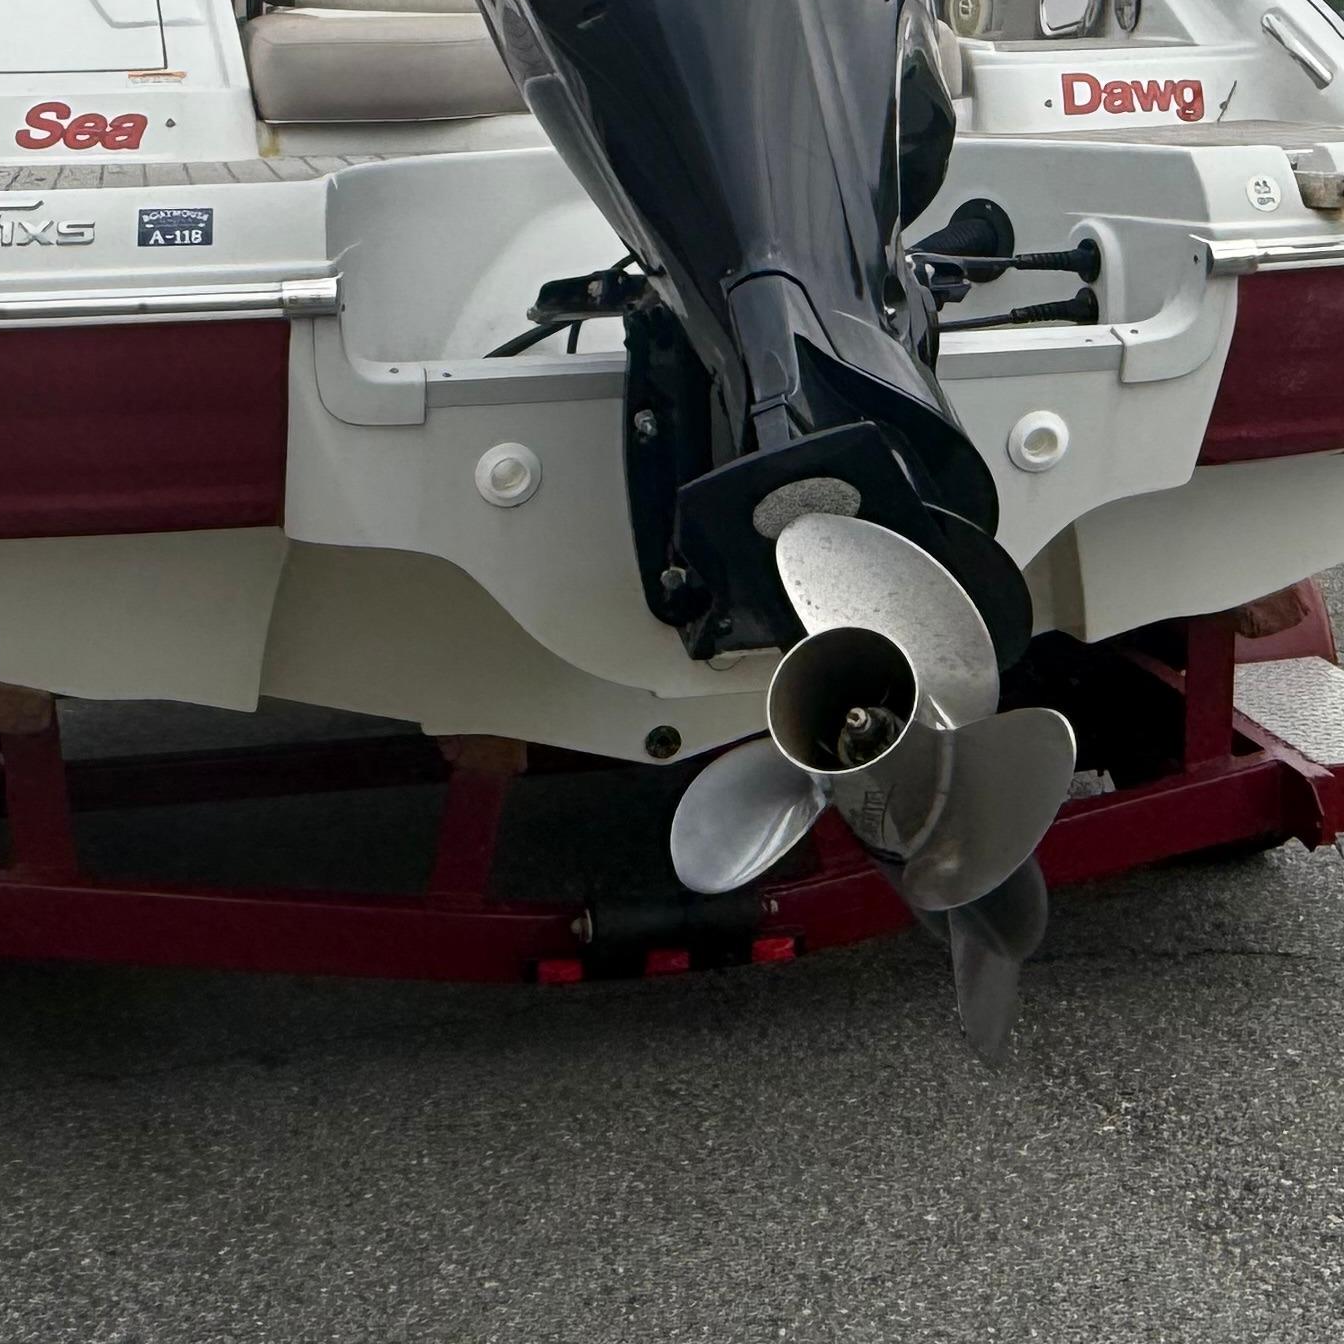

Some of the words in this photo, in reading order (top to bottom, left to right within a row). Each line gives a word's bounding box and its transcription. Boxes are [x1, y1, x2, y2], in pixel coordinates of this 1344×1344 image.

[1061, 72, 1205, 122] Dawg
[14, 101, 149, 151] Sea
[148, 229, 203, 245] A-118
